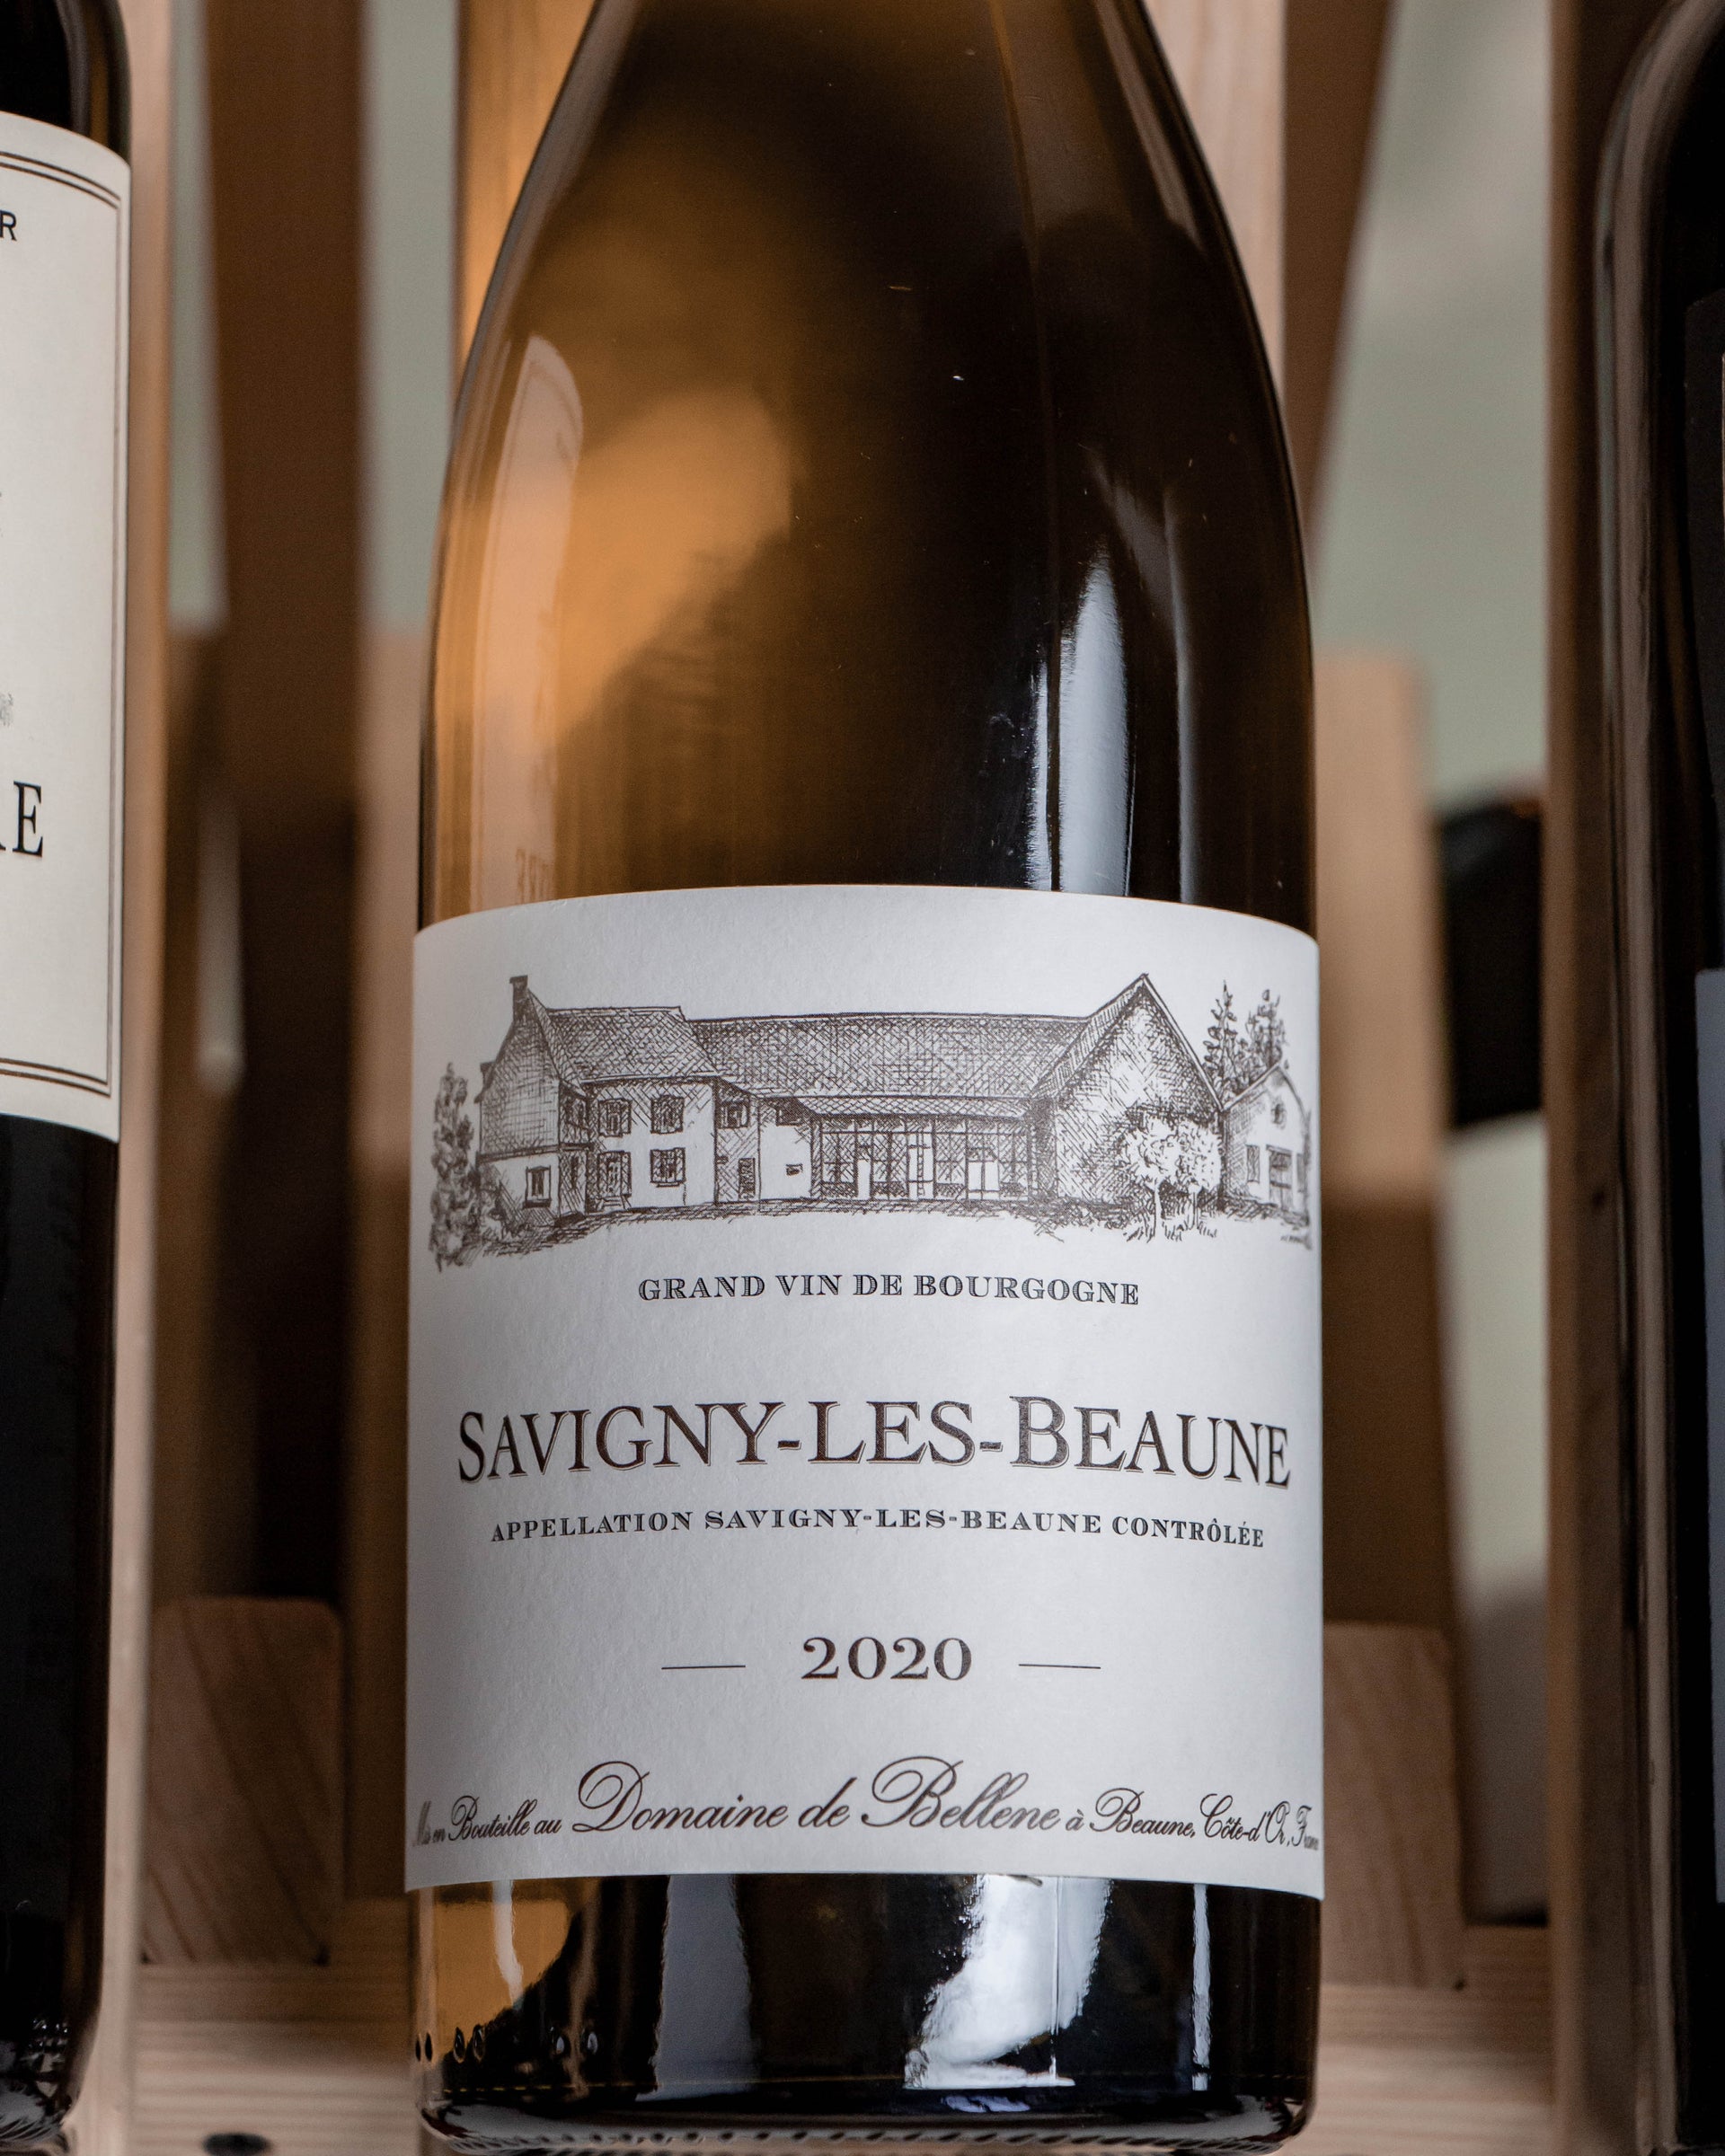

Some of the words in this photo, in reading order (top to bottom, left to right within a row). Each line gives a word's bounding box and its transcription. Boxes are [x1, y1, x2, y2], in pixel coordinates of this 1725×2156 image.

[0, 209, 17, 242] R
[0, 780, 43, 857] E
[638, 1274, 765, 1302] GRAND
[774, 1274, 843, 1296] VIN
[853, 1274, 903, 1296] DE
[913, 1274, 1139, 1306] BOURGOGNE
[458, 1395, 1291, 1490] SAVIGNY-LES-BEAUNE
[491, 1511, 694, 1542] APPELLATION
[704, 1508, 1101, 1534] SAVIGNY-LES-BEAUNE
[1111, 1515, 1264, 1549] CONTRÔLÉE
[801, 1636, 972, 1682] 2020
[447, 1795, 537, 1842] Bouteille
[533, 1817, 562, 1834] au
[571, 1761, 789, 1833] Domaine
[797, 1776, 858, 1828] de
[861, 1754, 1062, 1831] Bellene
[1065, 1807, 1085, 1832] à
[1088, 1787, 1197, 1839] Beaune,
